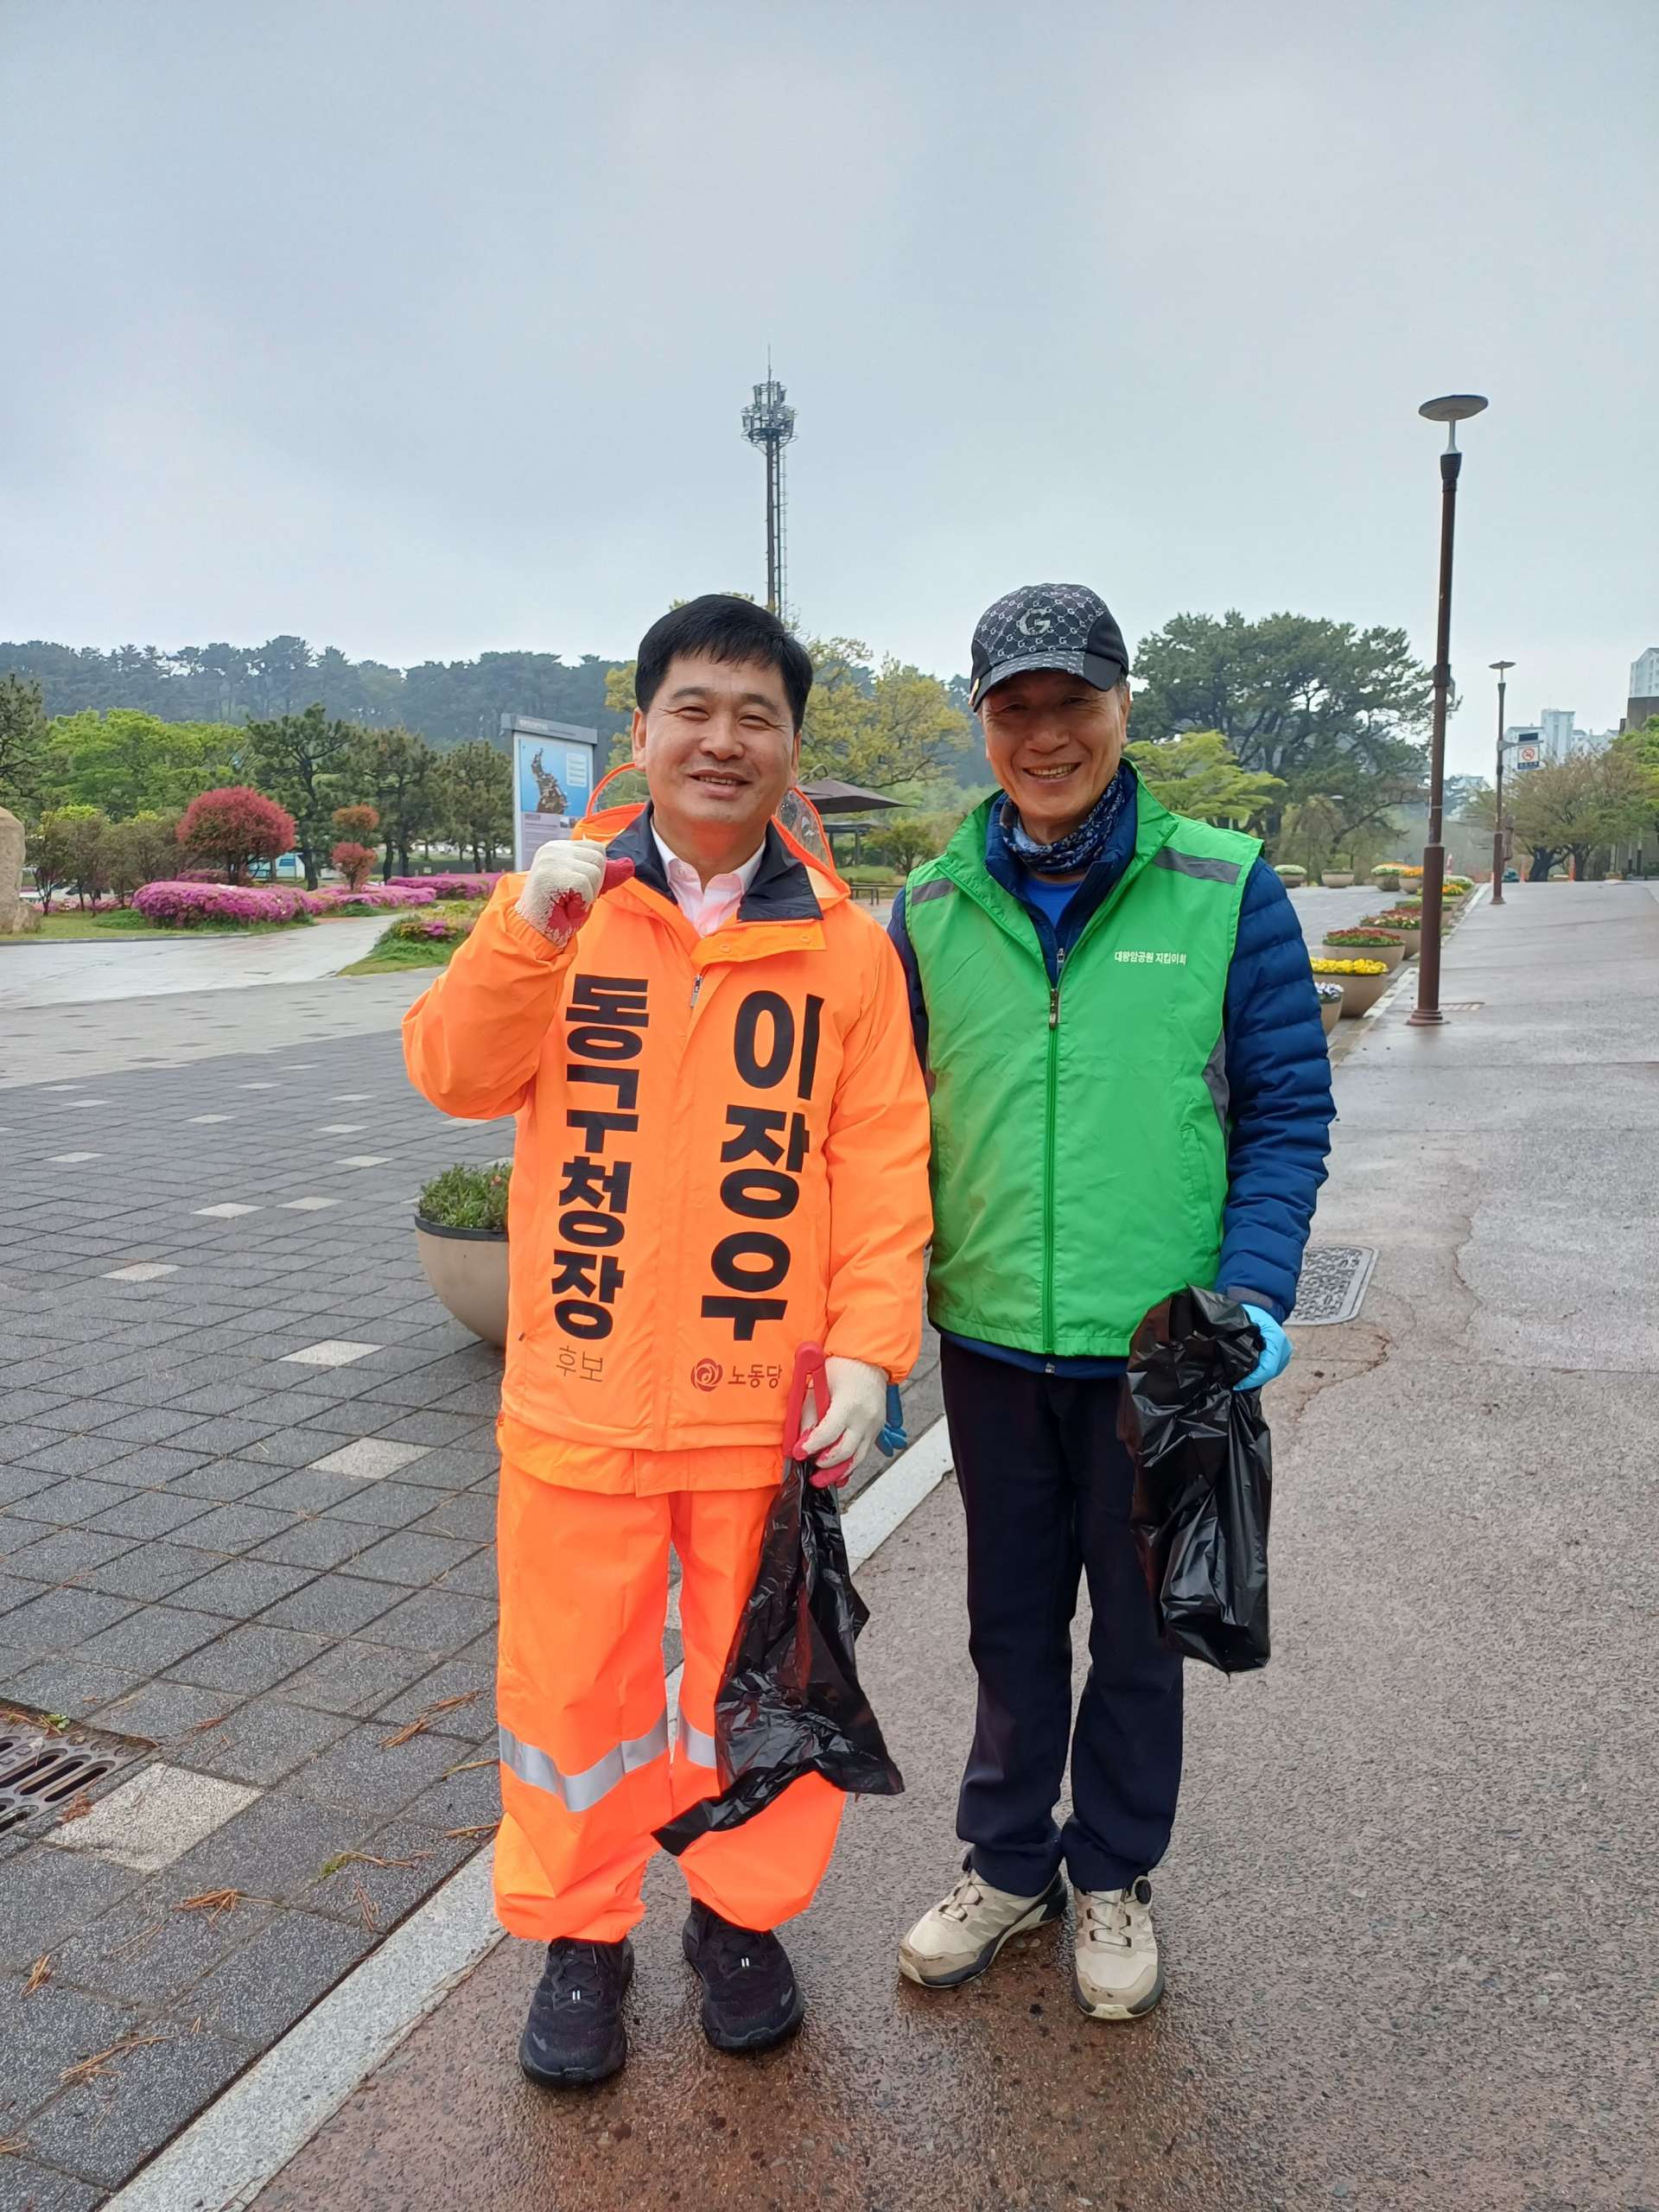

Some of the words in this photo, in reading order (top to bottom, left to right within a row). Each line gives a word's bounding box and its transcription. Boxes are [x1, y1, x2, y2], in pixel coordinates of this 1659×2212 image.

[1114, 950, 1154, 963] 대왕암공원
[551, 973, 650, 1340] 동구청장
[701, 989, 825, 1341] 이장우
[556, 1344, 604, 1382] 후보
[728, 1364, 783, 1389] 노동당
